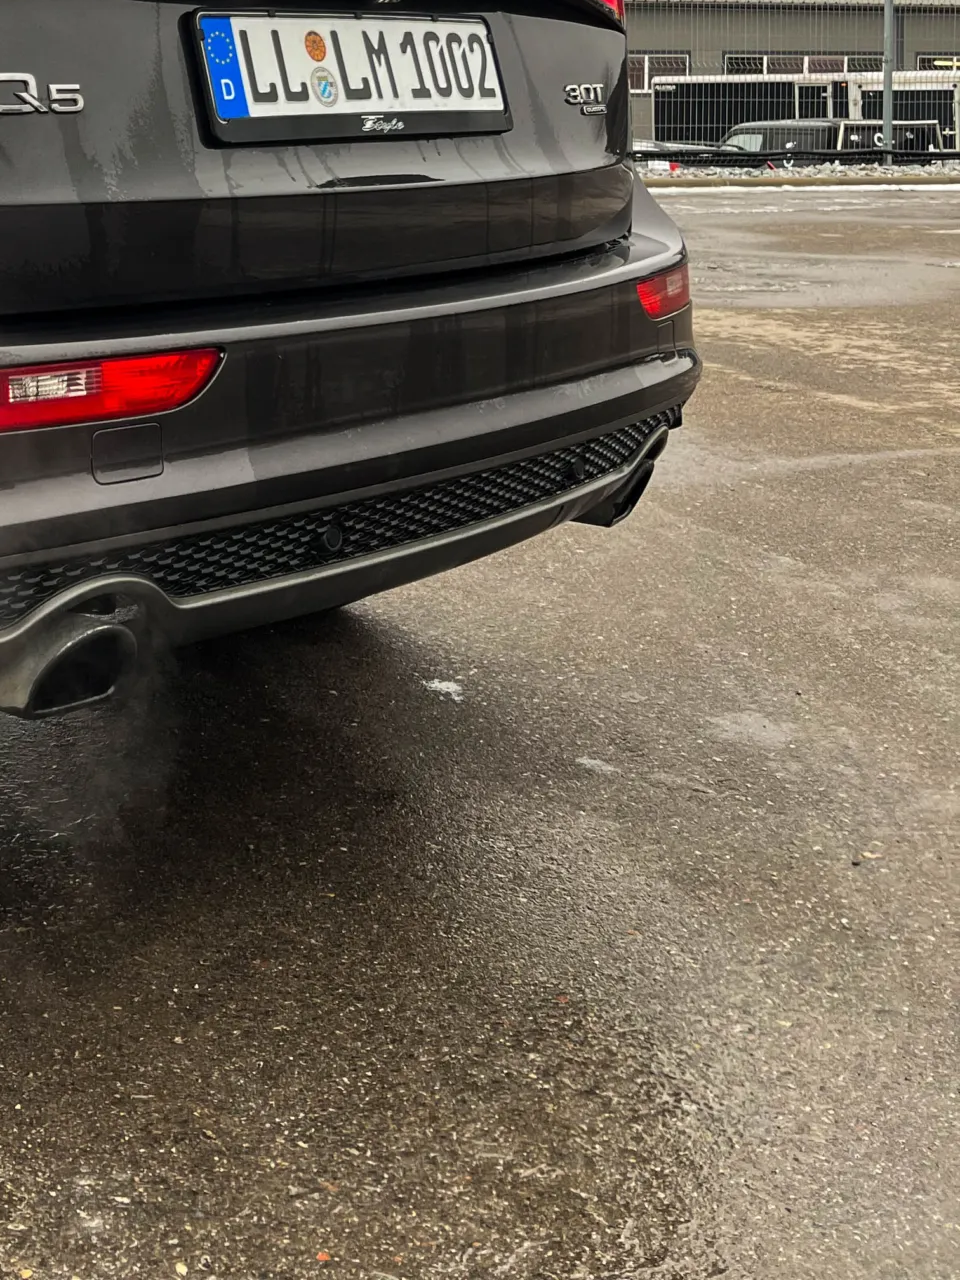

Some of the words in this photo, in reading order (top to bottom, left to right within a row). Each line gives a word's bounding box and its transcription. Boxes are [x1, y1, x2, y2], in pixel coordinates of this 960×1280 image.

[221, 78, 235, 101] D
[240, 30, 309, 102] LL
[331, 30, 399, 100] LM
[400, 31, 496, 99] 1002
